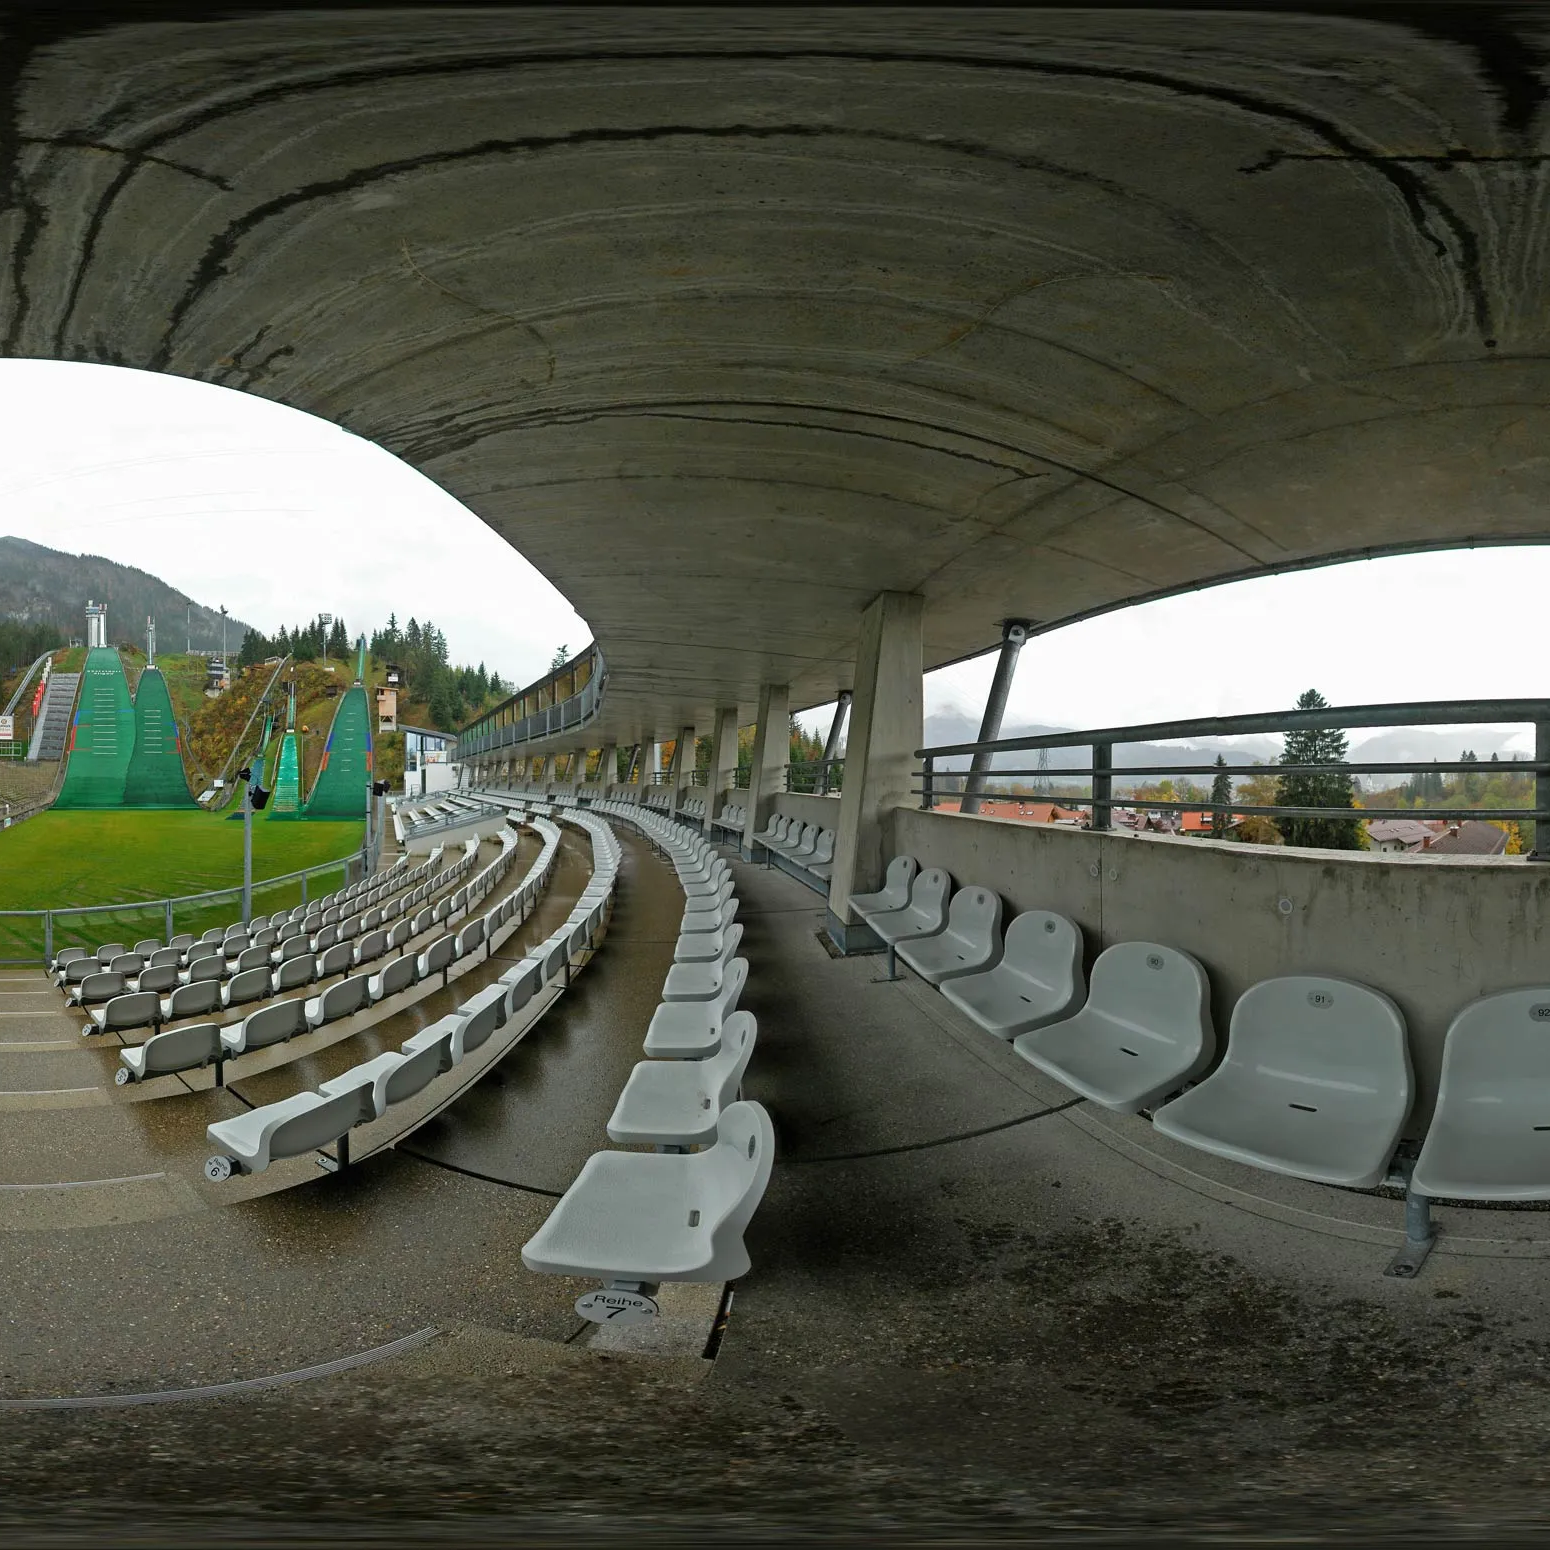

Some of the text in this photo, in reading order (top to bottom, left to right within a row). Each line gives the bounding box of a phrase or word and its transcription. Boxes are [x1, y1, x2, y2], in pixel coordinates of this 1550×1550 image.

[1315, 995, 1325, 1003] 91
[1538, 1008, 1550, 1017] 92
[211, 1167, 220, 1177] 6
[594, 1295, 643, 1307] Reihe
[606, 1306, 626, 1319] 7
